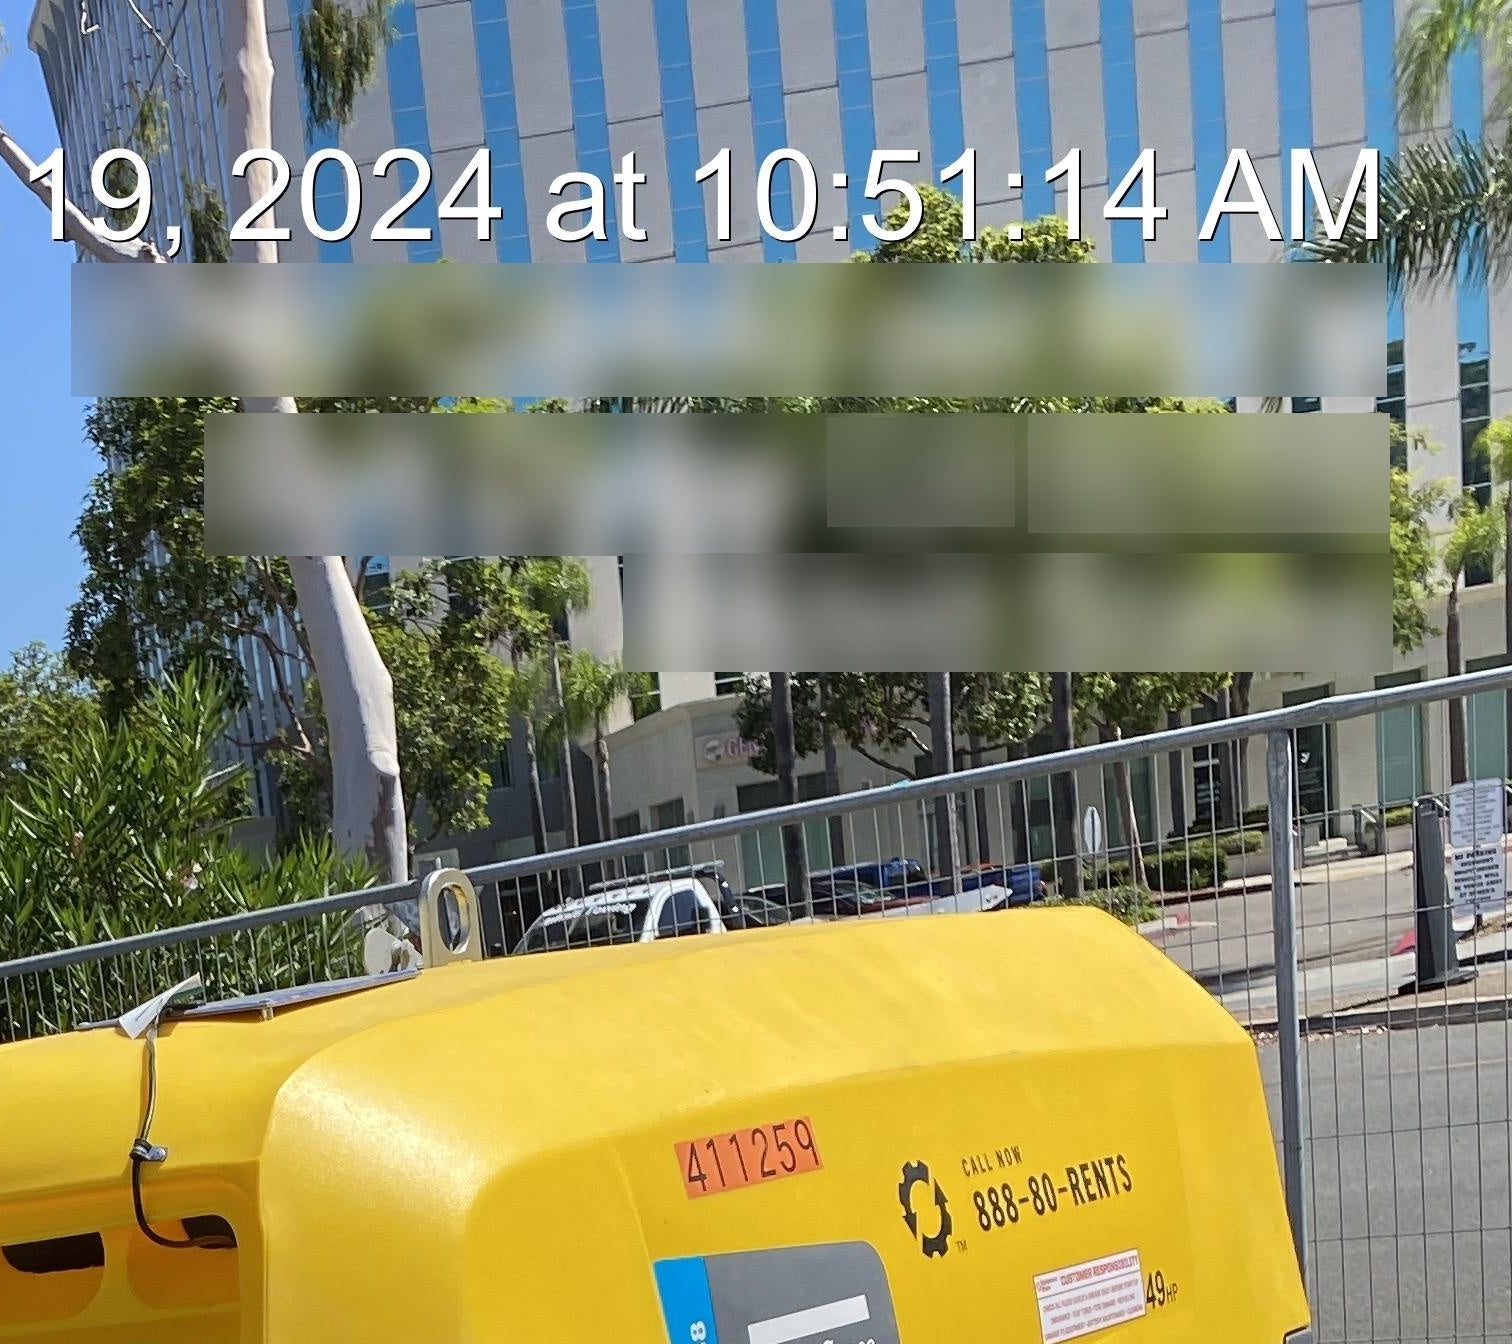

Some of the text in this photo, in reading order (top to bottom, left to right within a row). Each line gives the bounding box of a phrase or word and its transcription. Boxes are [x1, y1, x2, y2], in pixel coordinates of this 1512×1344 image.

[688, 1119, 819, 1192] 411259
[961, 1145, 1023, 1177] CALL NOW
[973, 1154, 1133, 1232] 888-80-RENTS
